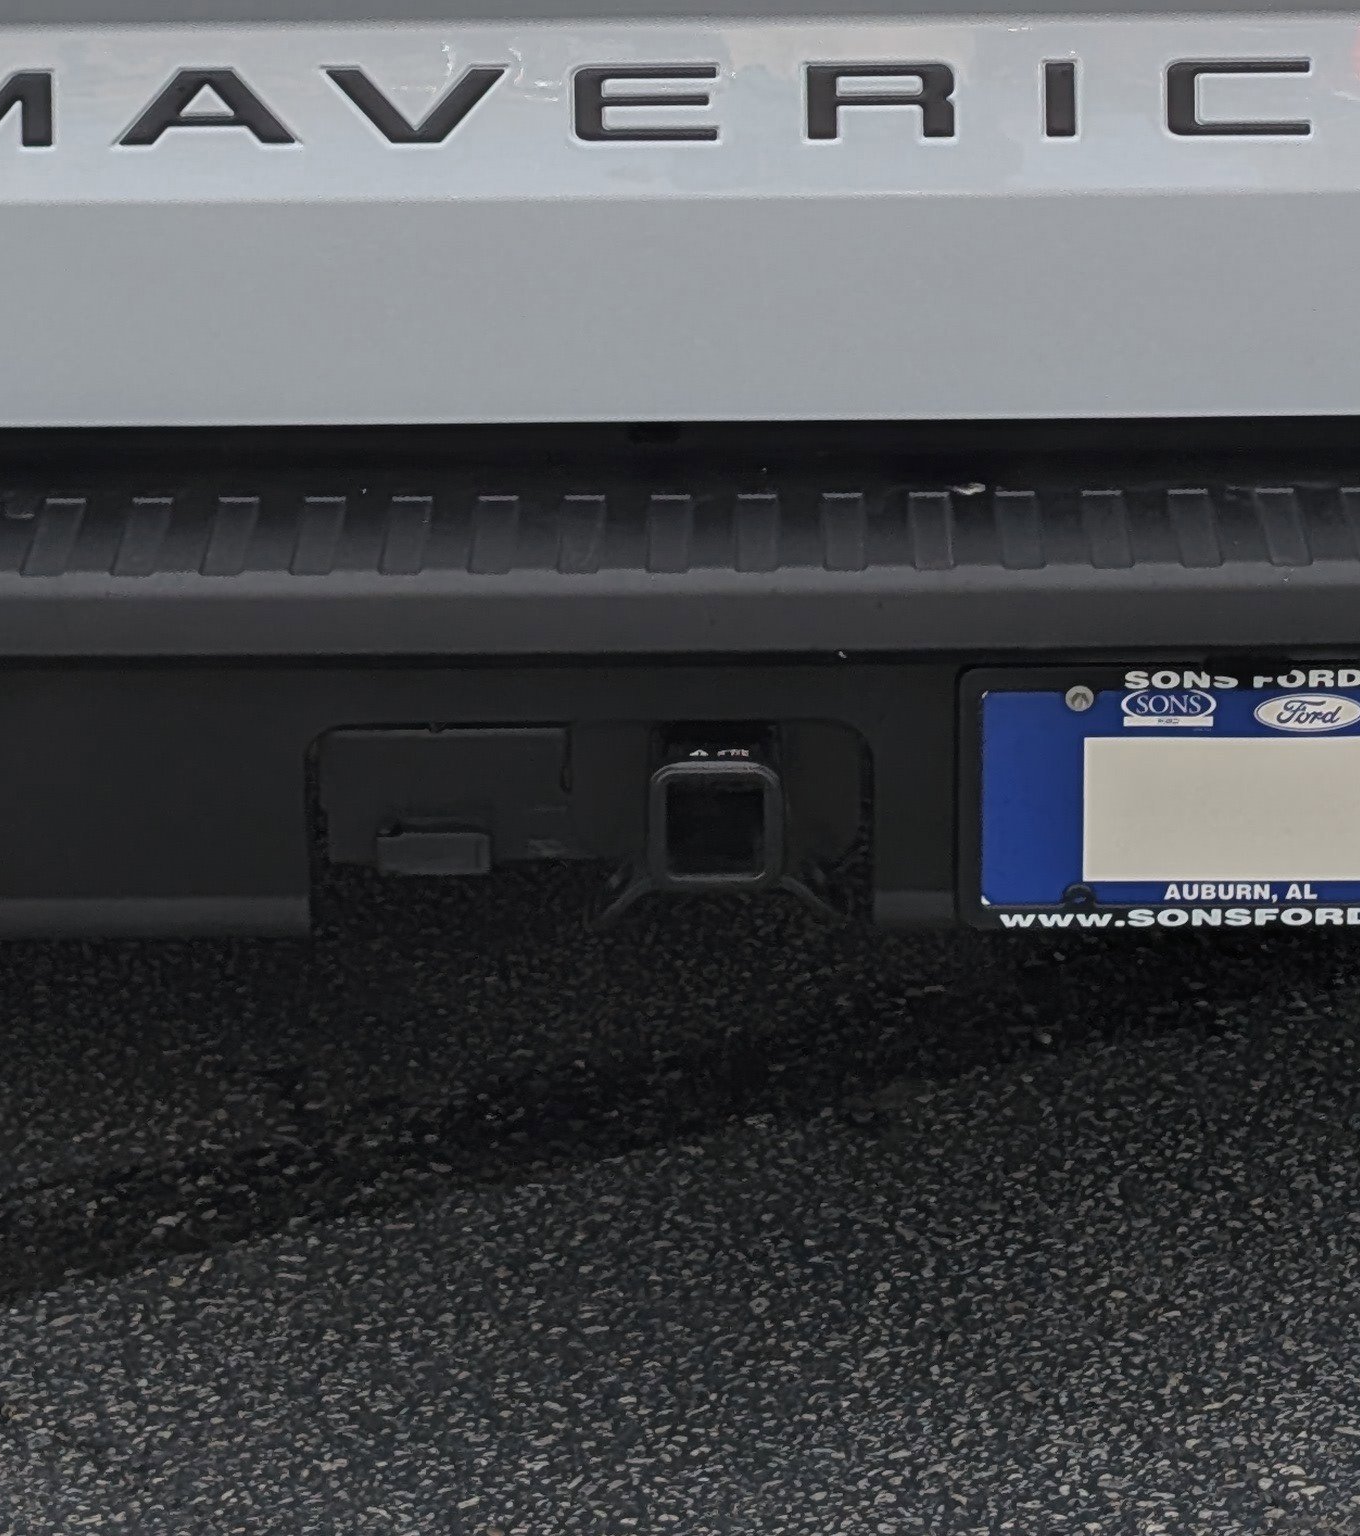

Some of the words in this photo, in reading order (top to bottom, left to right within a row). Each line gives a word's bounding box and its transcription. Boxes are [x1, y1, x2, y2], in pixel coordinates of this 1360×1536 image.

[1124, 670, 1239, 689] SONS
[1136, 695, 1201, 714] SONS
[1276, 700, 1342, 724] Ford
[1164, 883, 1278, 903] AUBURN,
[1285, 883, 1318, 900] AL
